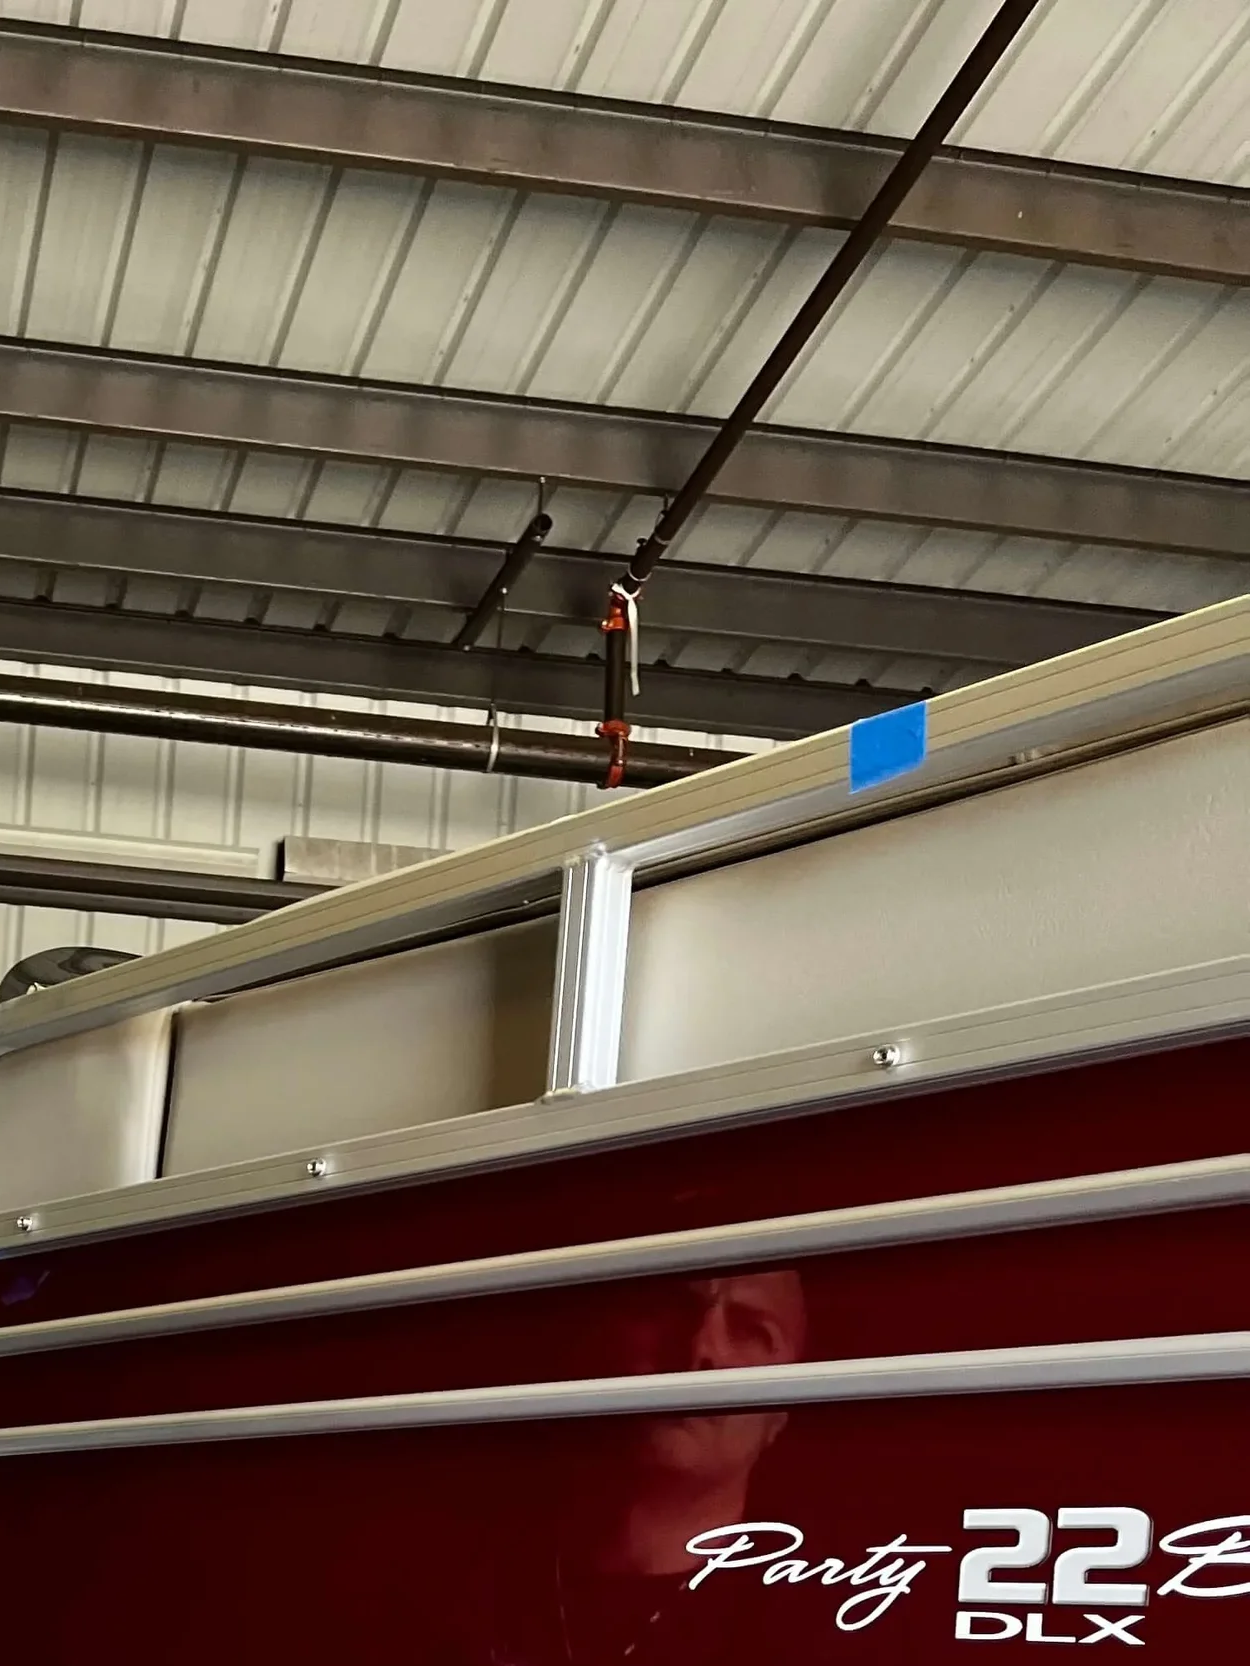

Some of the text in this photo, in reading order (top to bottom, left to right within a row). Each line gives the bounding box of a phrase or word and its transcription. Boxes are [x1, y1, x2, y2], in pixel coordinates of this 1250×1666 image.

[685, 1521, 952, 1631] Party
[958, 1507, 1152, 1605] 22
[955, 1611, 1146, 1645] DLX
